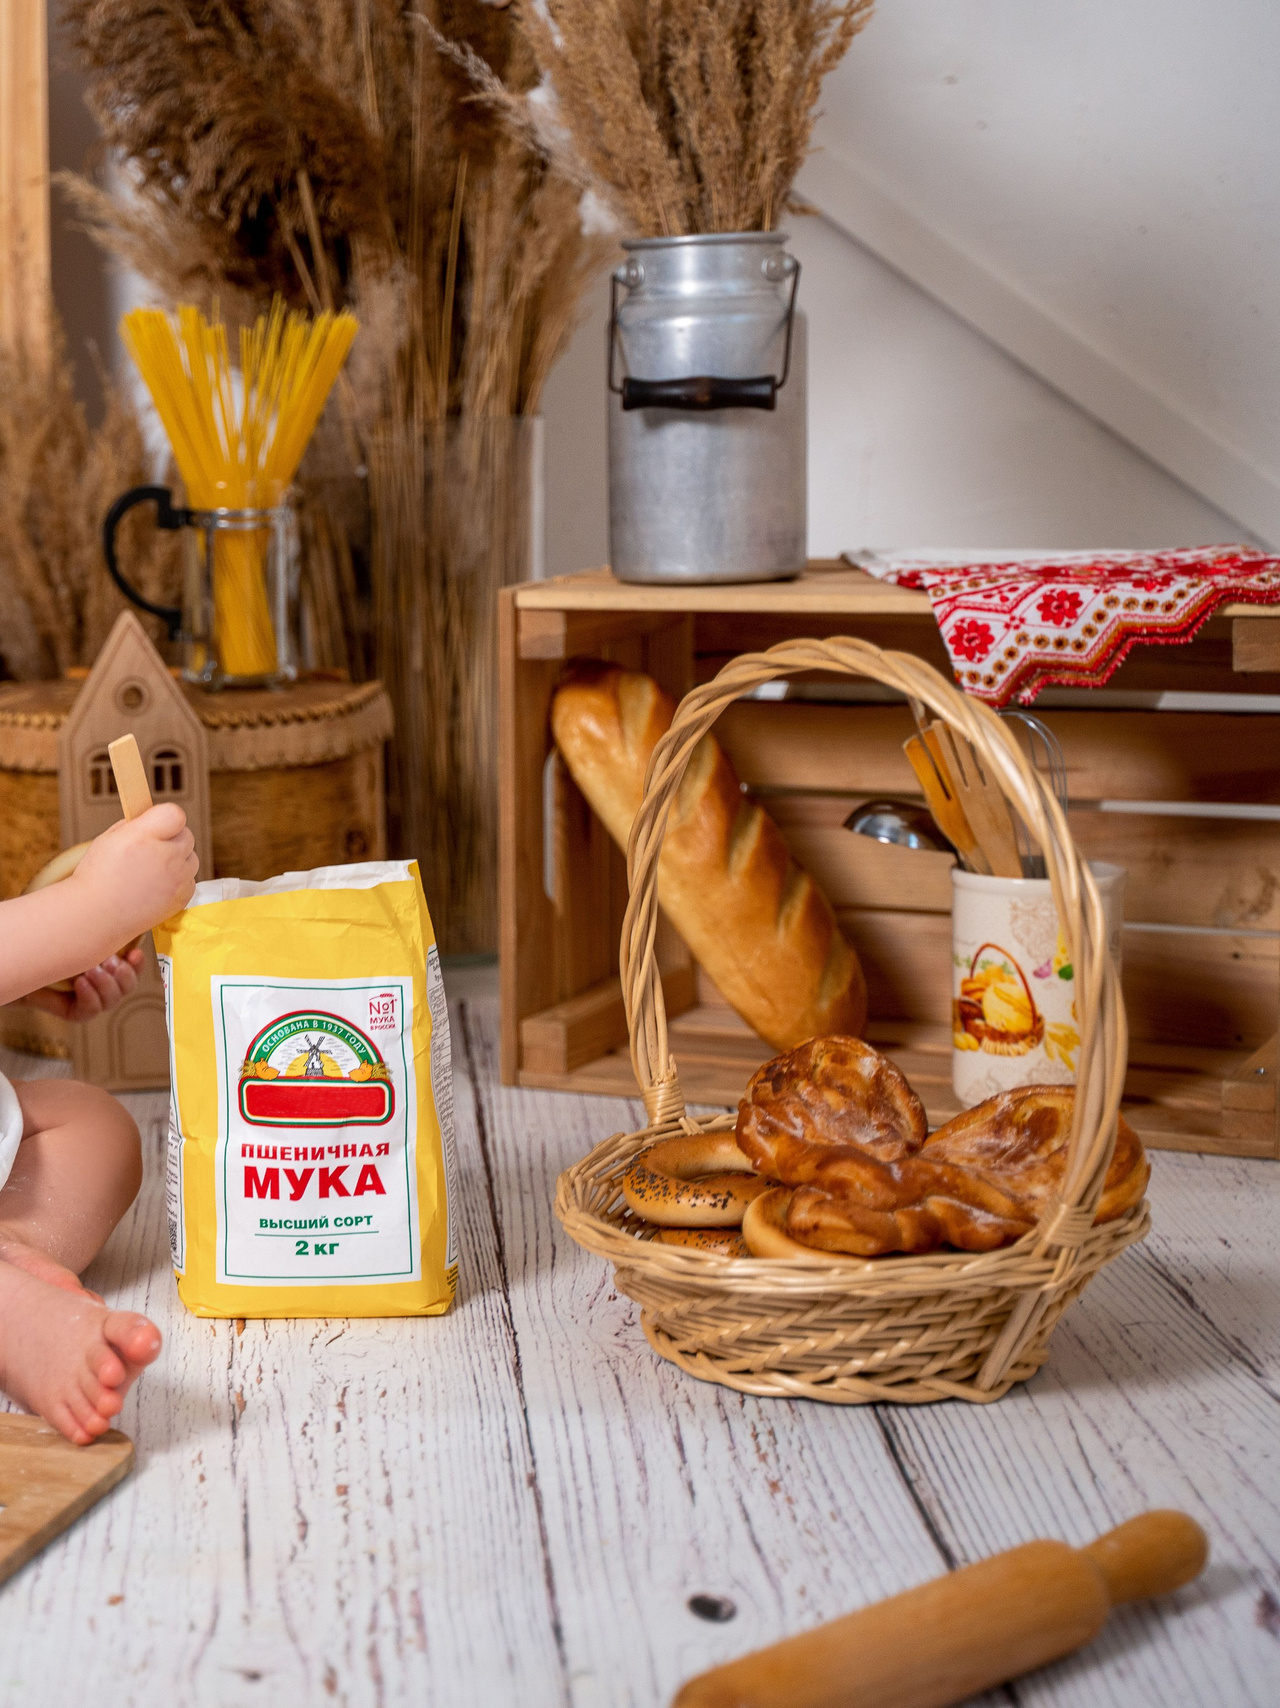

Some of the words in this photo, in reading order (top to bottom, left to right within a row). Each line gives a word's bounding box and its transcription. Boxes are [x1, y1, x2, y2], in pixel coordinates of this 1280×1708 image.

[370, 1016, 395, 1024] МУКА
[262, 1020, 309, 1052] ОСНОВАНА
[313, 1020, 318, 1028] В
[322, 1021, 343, 1035] 1937
[344, 1032, 367, 1053] ГОДУ
[241, 1142, 390, 1161] ПШЕНИЧНАЯ
[244, 1164, 387, 1201] МУКА
[259, 1215, 329, 1229] ВЫСШИЙ
[333, 1215, 373, 1227] СОРТ
[295, 1240, 309, 1255] 2
